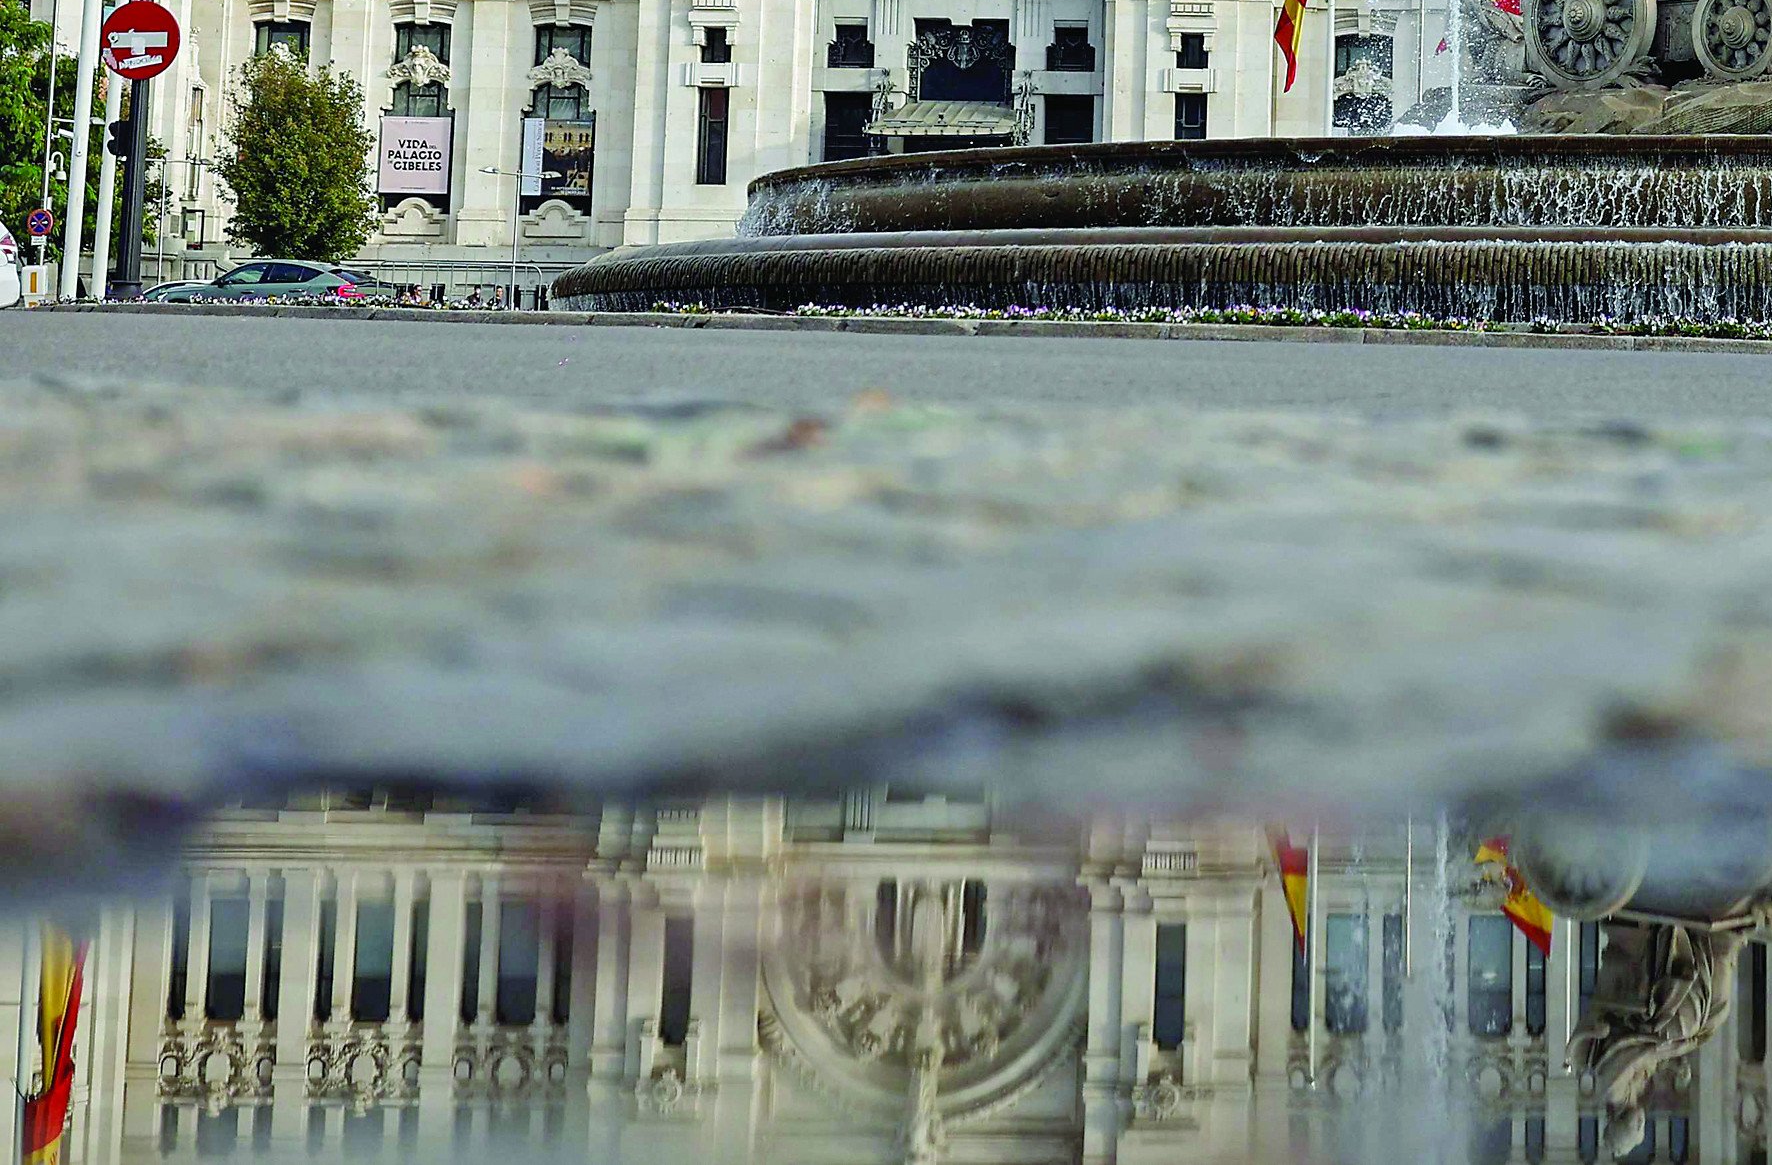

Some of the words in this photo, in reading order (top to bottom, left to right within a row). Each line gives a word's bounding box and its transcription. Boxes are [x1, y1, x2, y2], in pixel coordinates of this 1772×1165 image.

[398, 139, 428, 149] VIDA
[387, 150, 442, 160] PALACIO
[393, 161, 442, 171] CIBELES
